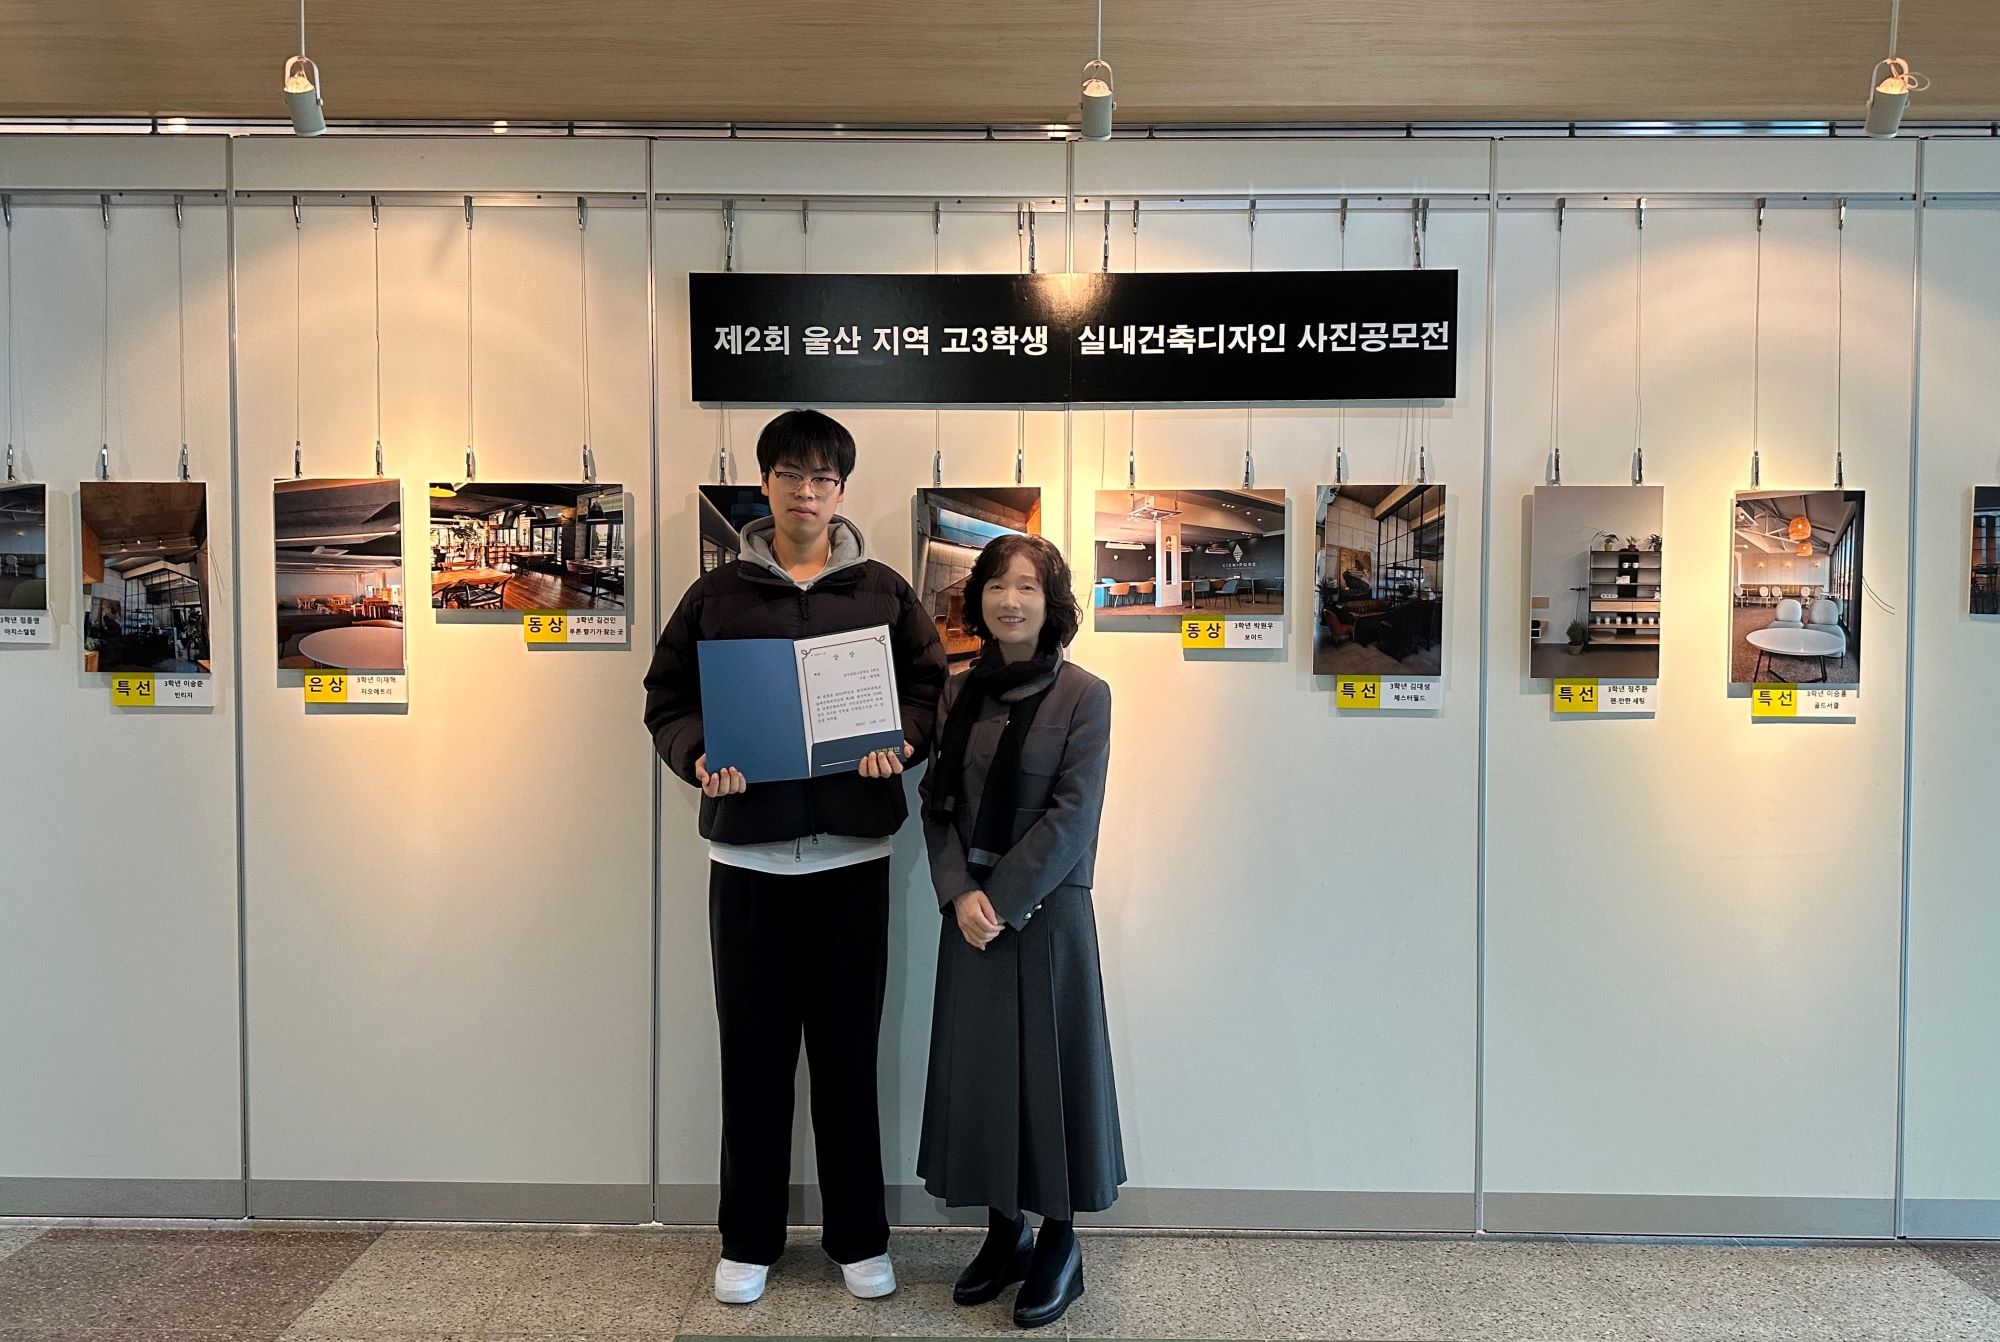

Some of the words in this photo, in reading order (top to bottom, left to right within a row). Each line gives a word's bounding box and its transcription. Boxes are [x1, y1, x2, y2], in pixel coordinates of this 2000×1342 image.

[713, 325, 791, 355] 제2회
[802, 325, 862, 355] 울산
[872, 325, 929, 355] 지역
[940, 325, 1048, 355] 고3학생
[1077, 323, 1286, 355] 실내건축디자인
[1297, 321, 1449, 353] 사진공모전
[356, 676, 374, 684] 3학년
